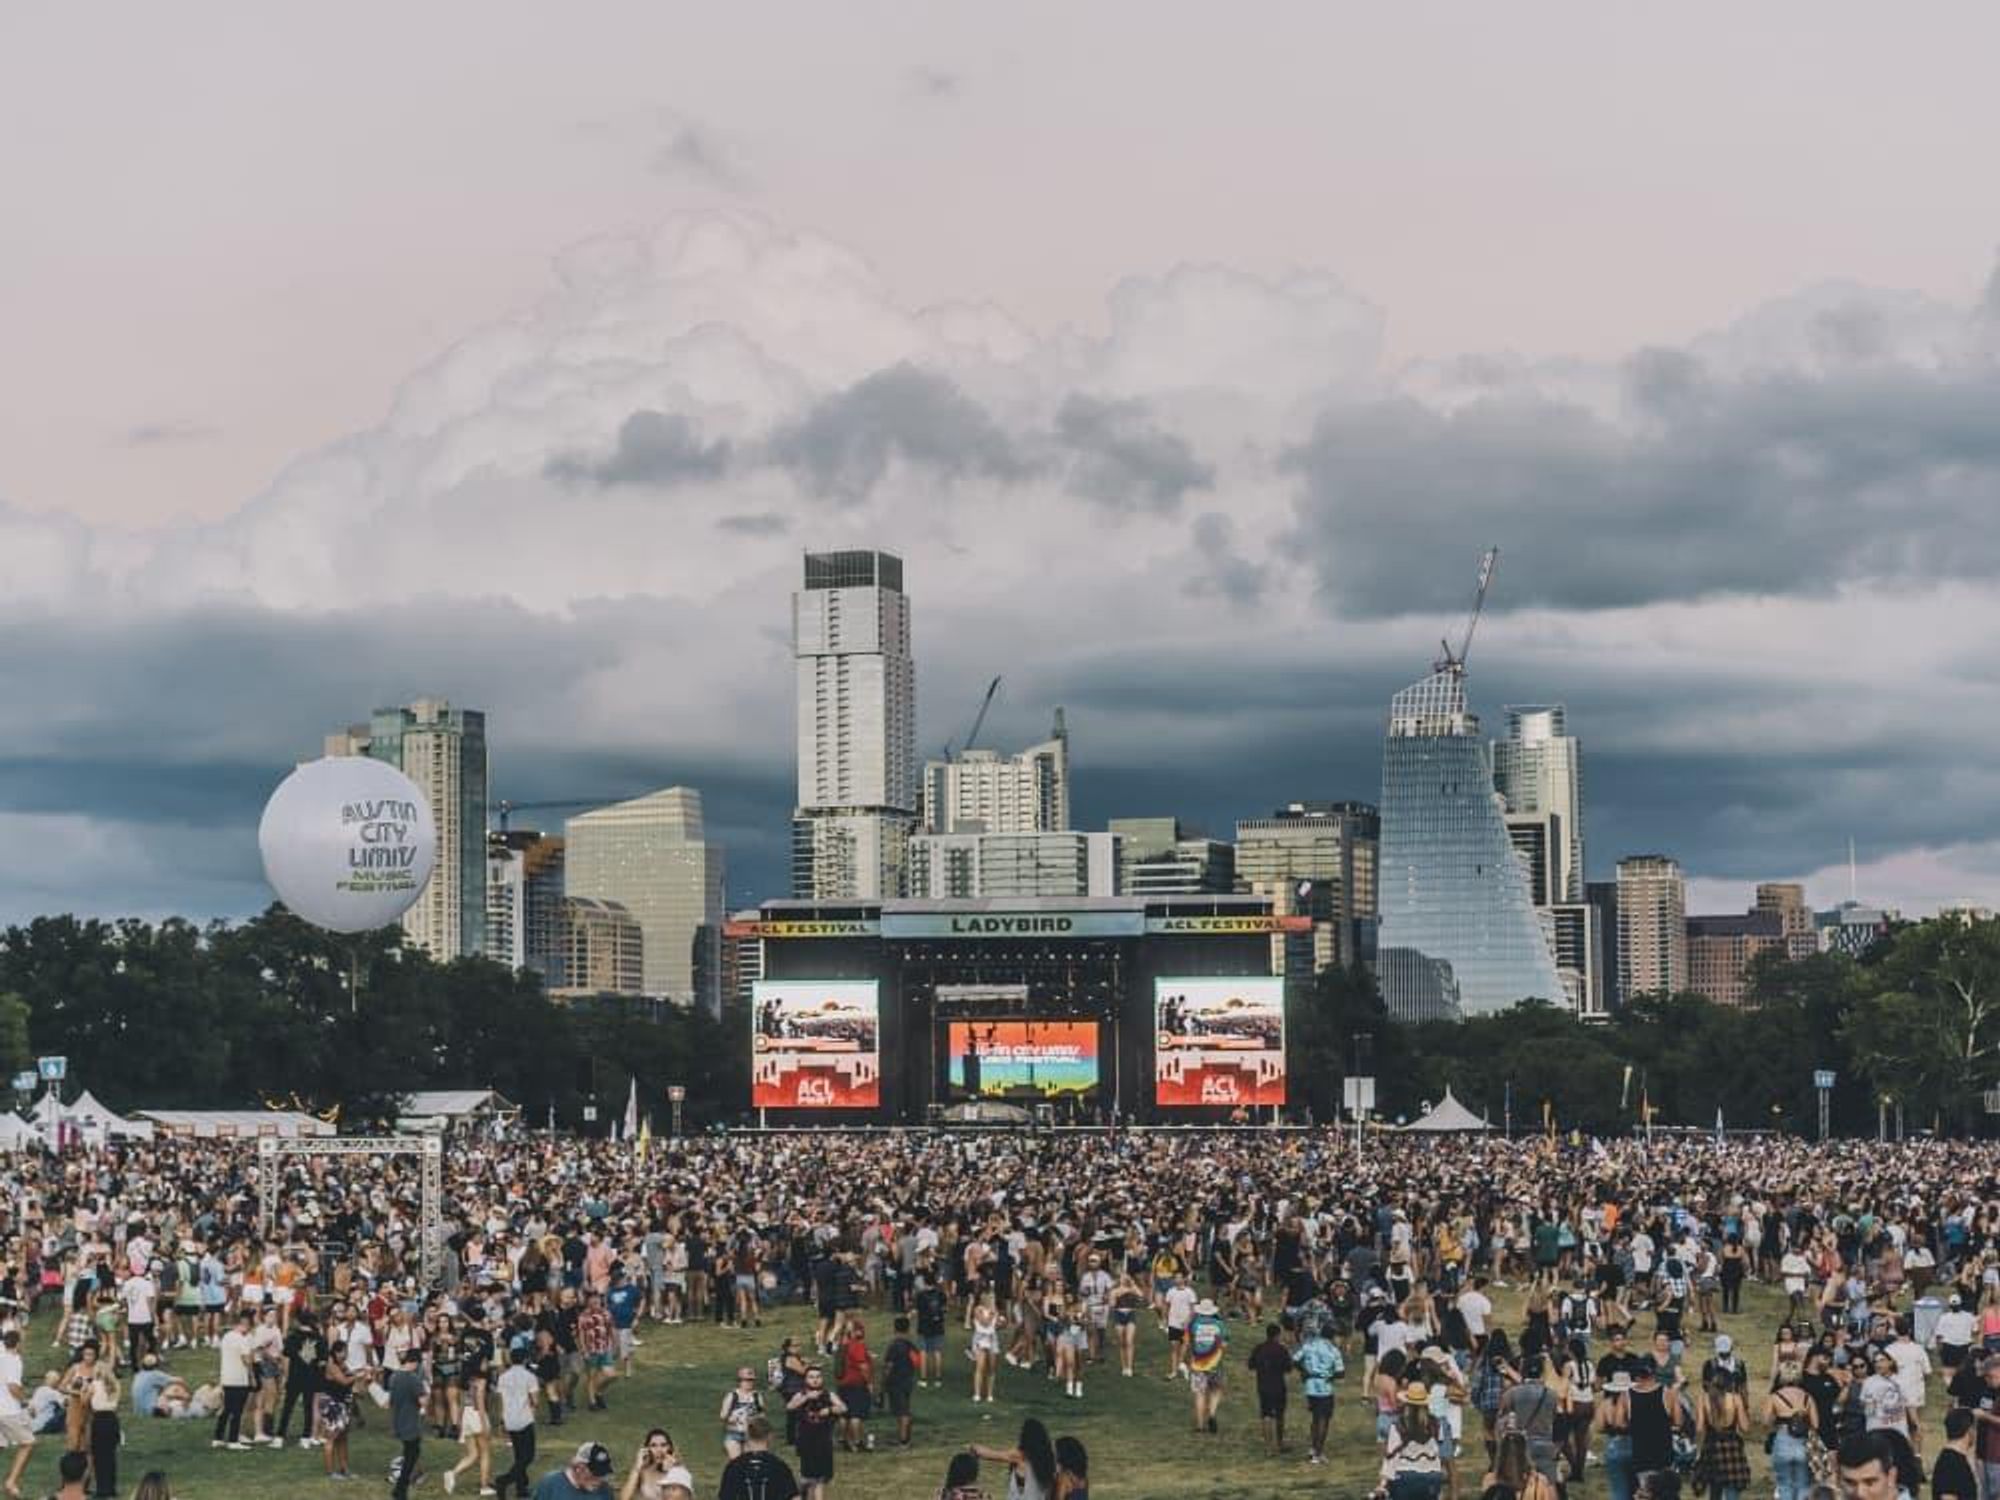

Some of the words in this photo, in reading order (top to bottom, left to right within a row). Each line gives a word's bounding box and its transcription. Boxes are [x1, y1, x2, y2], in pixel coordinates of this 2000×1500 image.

[342, 800, 417, 823] AUSTIN
[360, 822, 407, 843] CITY
[348, 846, 417, 868] LIMITS
[750, 923, 779, 934] ACL
[785, 923, 868, 934] FESTIVAL
[951, 917, 1073, 933] LADYBIRD
[1164, 919, 1196, 930] ACL
[1201, 919, 1285, 930] FESTIVAL
